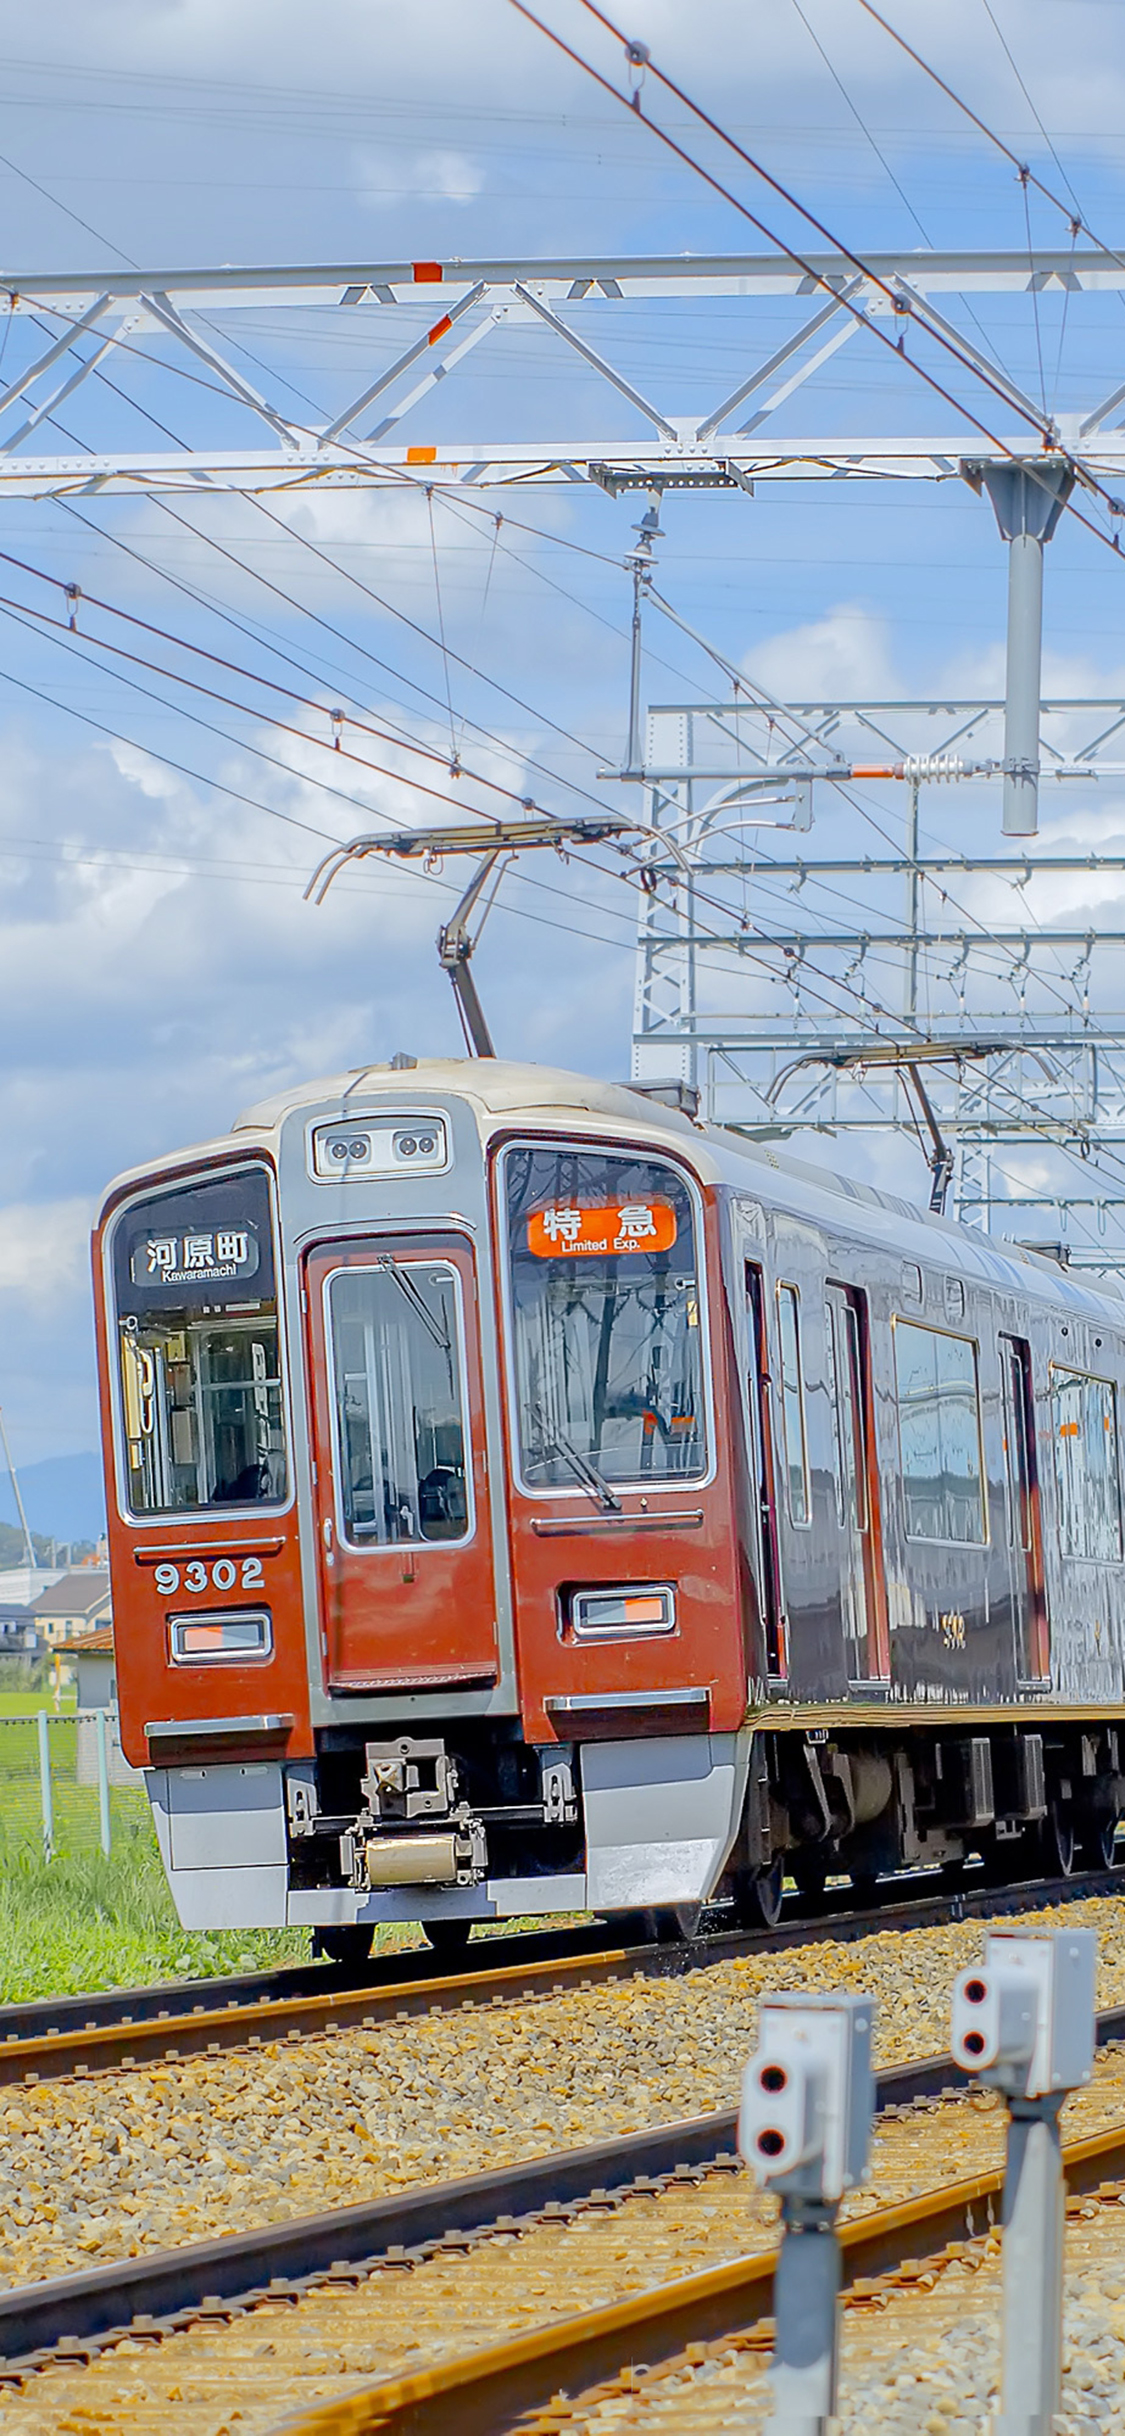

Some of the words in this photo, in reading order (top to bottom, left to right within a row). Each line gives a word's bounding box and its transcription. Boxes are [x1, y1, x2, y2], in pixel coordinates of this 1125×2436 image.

[543, 1205, 657, 1242] 特急
[146, 1231, 249, 1273] 河原町
[561, 1238, 608, 1252] Limited
[613, 1238, 641, 1251] Exp.
[161, 1264, 237, 1283] Kawaramachi
[154, 1557, 266, 1595] 9302
